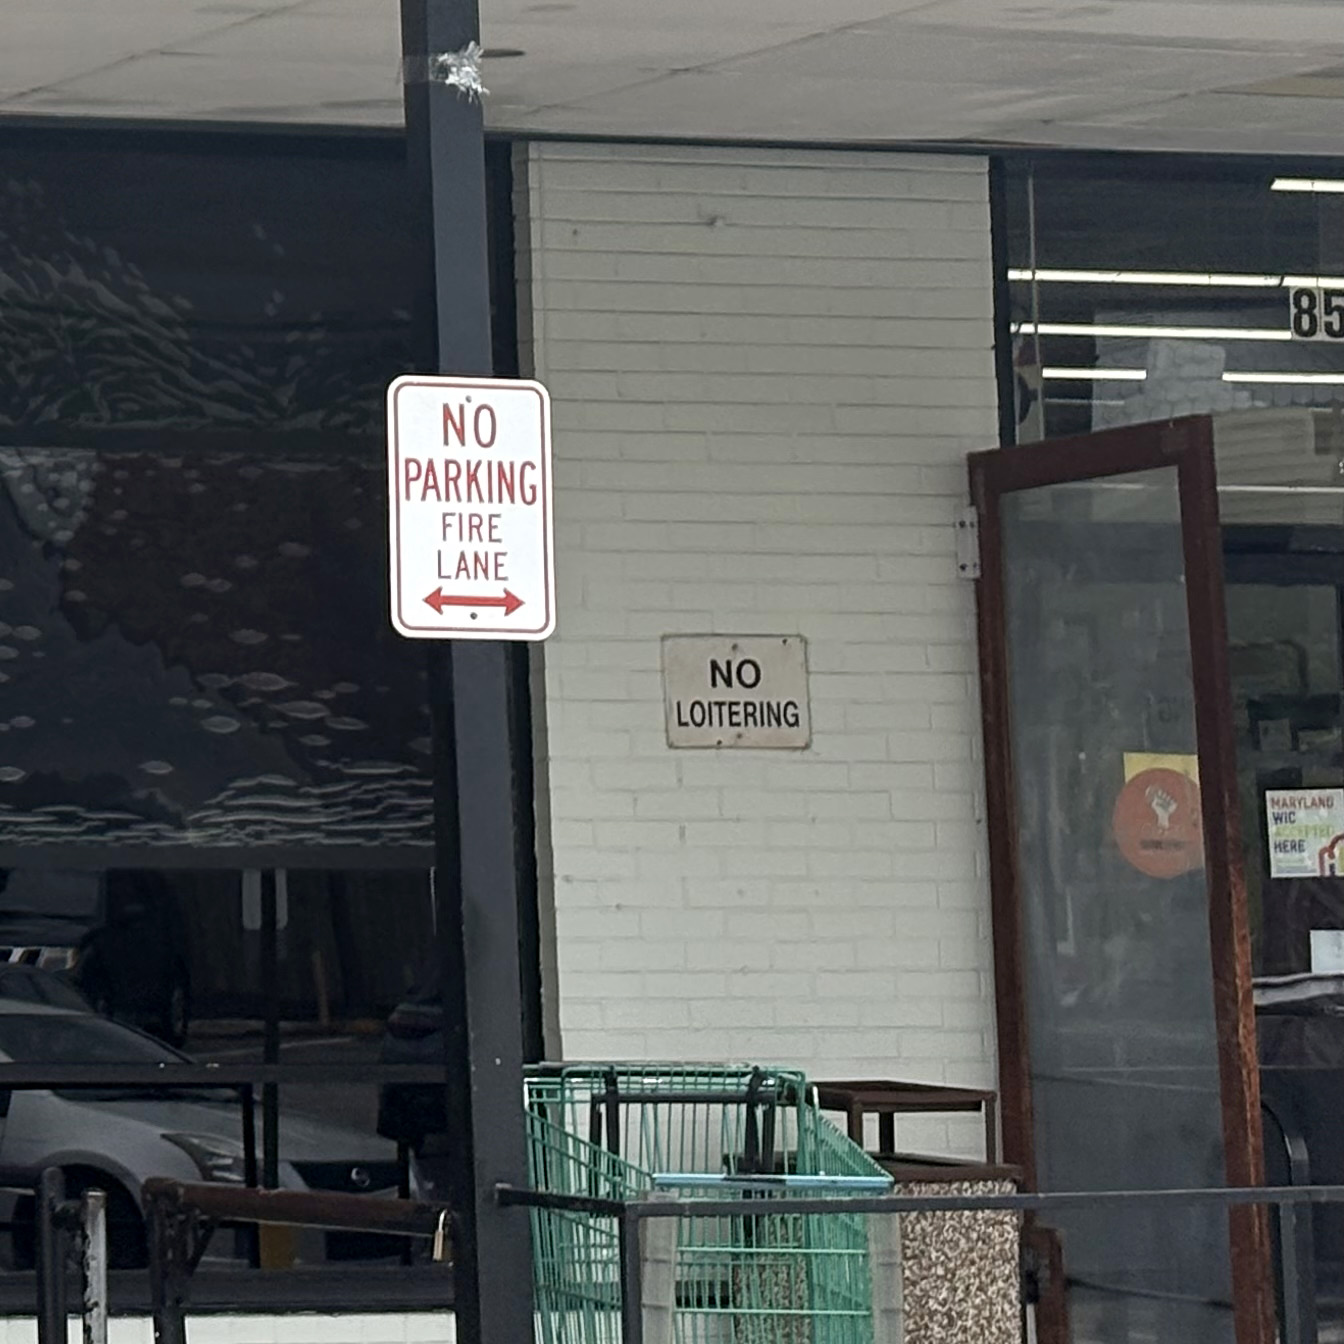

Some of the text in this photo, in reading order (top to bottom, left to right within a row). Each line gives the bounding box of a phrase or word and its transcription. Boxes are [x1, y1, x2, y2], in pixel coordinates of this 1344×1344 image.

[441, 402, 498, 450] NO
[403, 457, 538, 506] PARKING
[441, 512, 503, 544] FIRE
[436, 549, 510, 582] LANE
[709, 658, 762, 689] NO
[676, 699, 801, 729] LOITERING
[1270, 795, 1334, 809] MARYLAND
[1272, 810, 1296, 825] WIC
[1273, 838, 1305, 854] HERE
